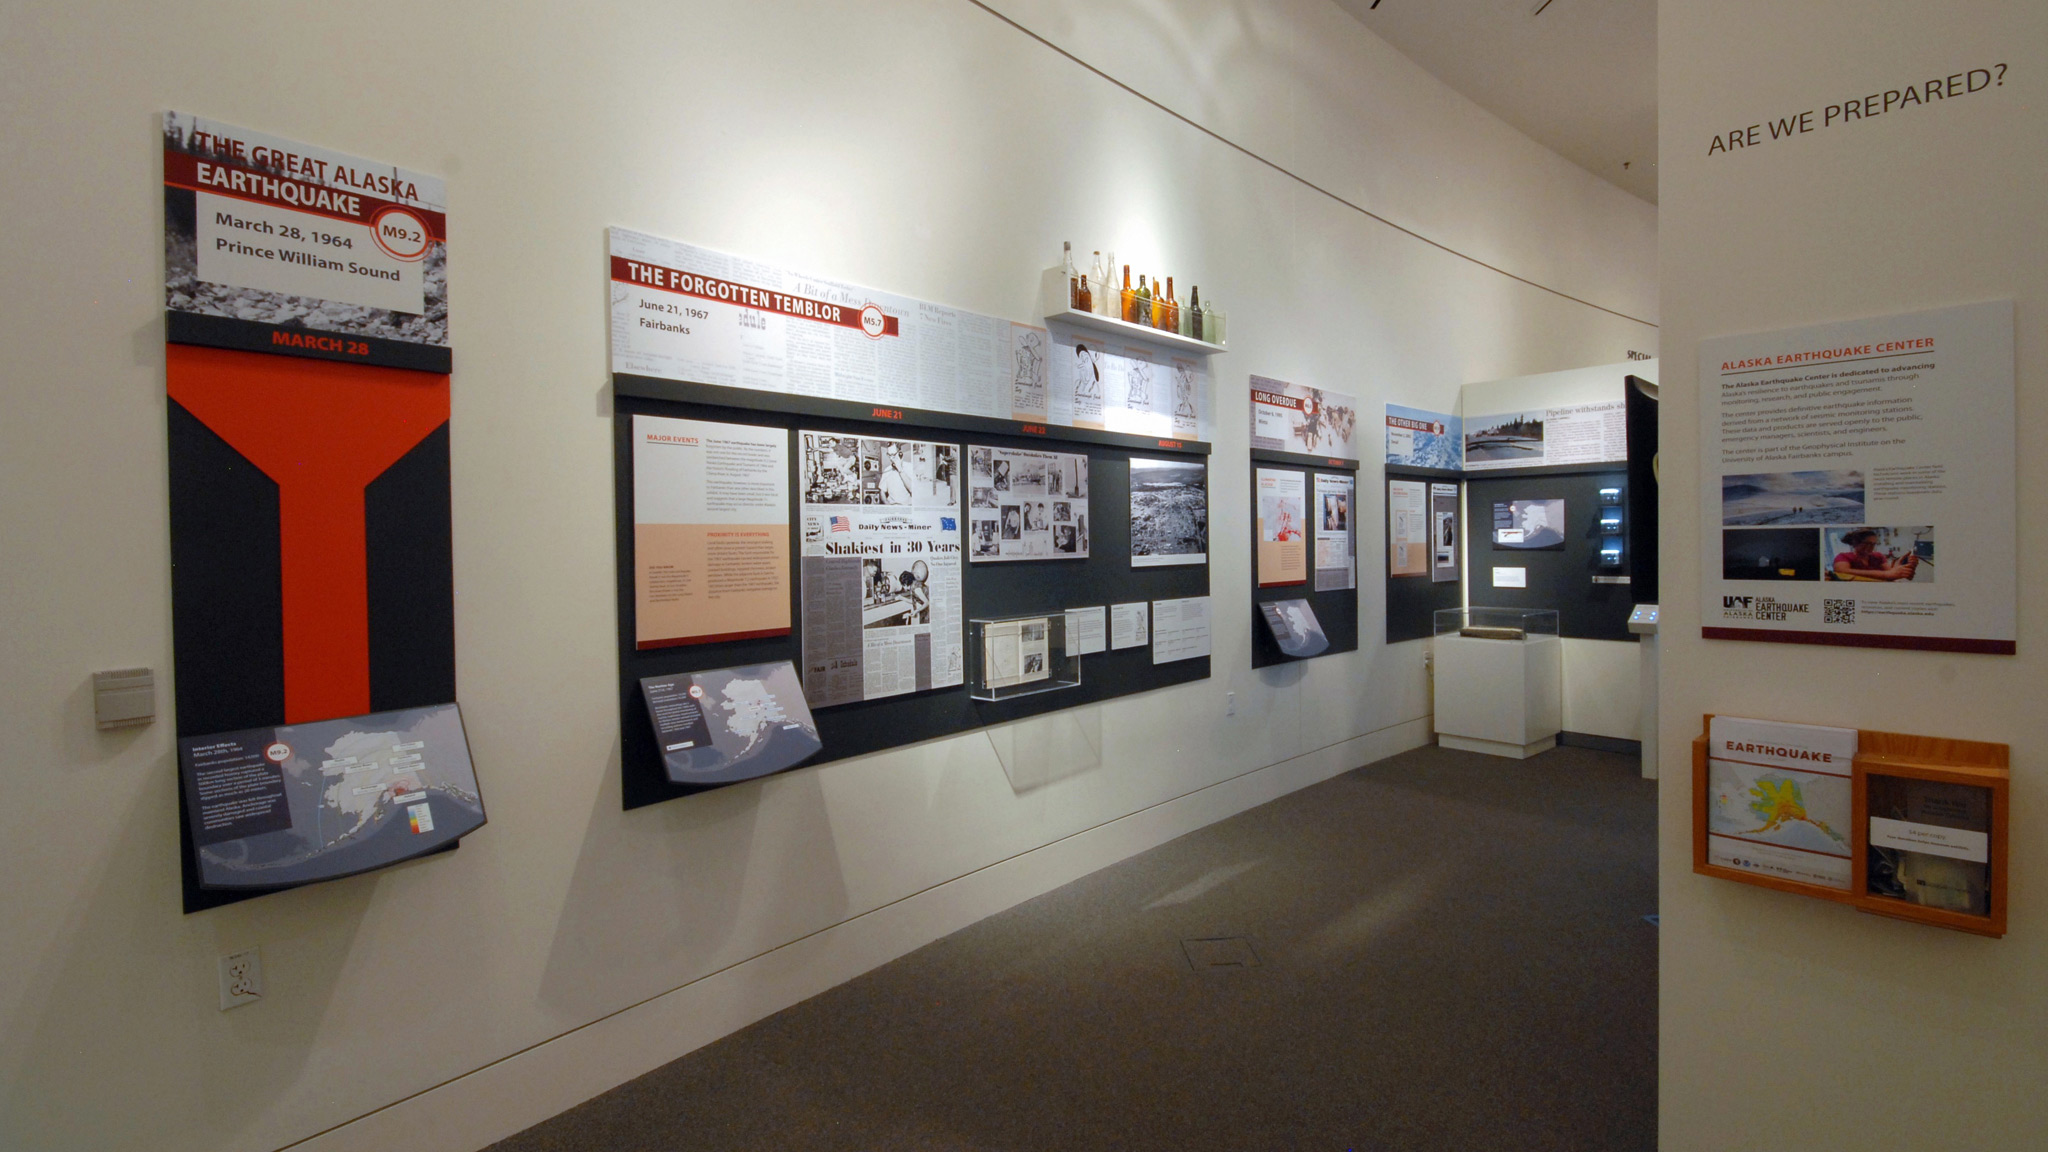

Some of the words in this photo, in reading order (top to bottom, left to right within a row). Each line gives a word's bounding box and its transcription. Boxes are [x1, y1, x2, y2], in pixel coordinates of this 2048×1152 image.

[1708, 124, 1760, 156] ARE
[1768, 111, 1814, 140] WE
[1824, 64, 2008, 126] PREPARED?
[196, 131, 244, 156] THE
[252, 146, 328, 180] GREAT
[334, 166, 418, 201] ALASKA
[197, 162, 360, 216] EARTHQUAKE
[216, 212, 273, 234] March
[279, 225, 306, 242] 28,
[312, 232, 352, 250] 1964
[383, 225, 421, 242] M9.2
[216, 238, 274, 259] Prince
[278, 248, 344, 272] William
[348, 262, 400, 282] Sound
[628, 262, 664, 286] THE
[670, 271, 770, 308] FORGOTTEN
[774, 294, 841, 322] TEMBLOR
[820, 288, 831, 300] of
[639, 298, 664, 312] June
[667, 304, 682, 317] 21,
[685, 307, 709, 320] 1967
[640, 318, 690, 335] Fairbanks
[864, 316, 882, 327] M5.7
[272, 331, 342, 352] MARCH
[347, 342, 369, 356] 28
[1721, 357, 1772, 371] ALASKA
[1777, 345, 1871, 364] EARTHQUAKE
[1876, 338, 1934, 353] CENTER
[1760, 377, 1803, 386] Earthquake
[1839, 368, 1879, 378] dedicated
[1891, 363, 1935, 372] advancing
[1790, 382, 1833, 391] earthquakes
[1887, 373, 1919, 381] through
[1255, 391, 1270, 402] LONG
[1272, 394, 1296, 408] OVERDUE
[1809, 390, 1831, 399] public
[872, 408, 892, 418] JUNE
[893, 410, 902, 419] 21
[1546, 409, 1573, 417] Pipeline
[1575, 403, 1614, 413] withstands
[1758, 408, 1787, 416] provides
[1824, 401, 1866, 410] earthquake
[1867, 397, 1912, 406] information
[1397, 418, 1410, 427] OTHER
[1773, 424, 1804, 432] products
[1819, 420, 1843, 428] served
[647, 434, 671, 442] MAJOR
[673, 436, 699, 444] EVENTS
[1802, 442, 1846, 450] Geophysical
[826, 541, 884, 555] Shakiest
[890, 541, 901, 553] in
[907, 541, 922, 552] 30
[927, 541, 960, 553] Years
[1755, 603, 1810, 613] EARTHQUAKE
[1755, 612, 1786, 621] CENTER
[1726, 740, 1832, 763] EARTHQUAKE
